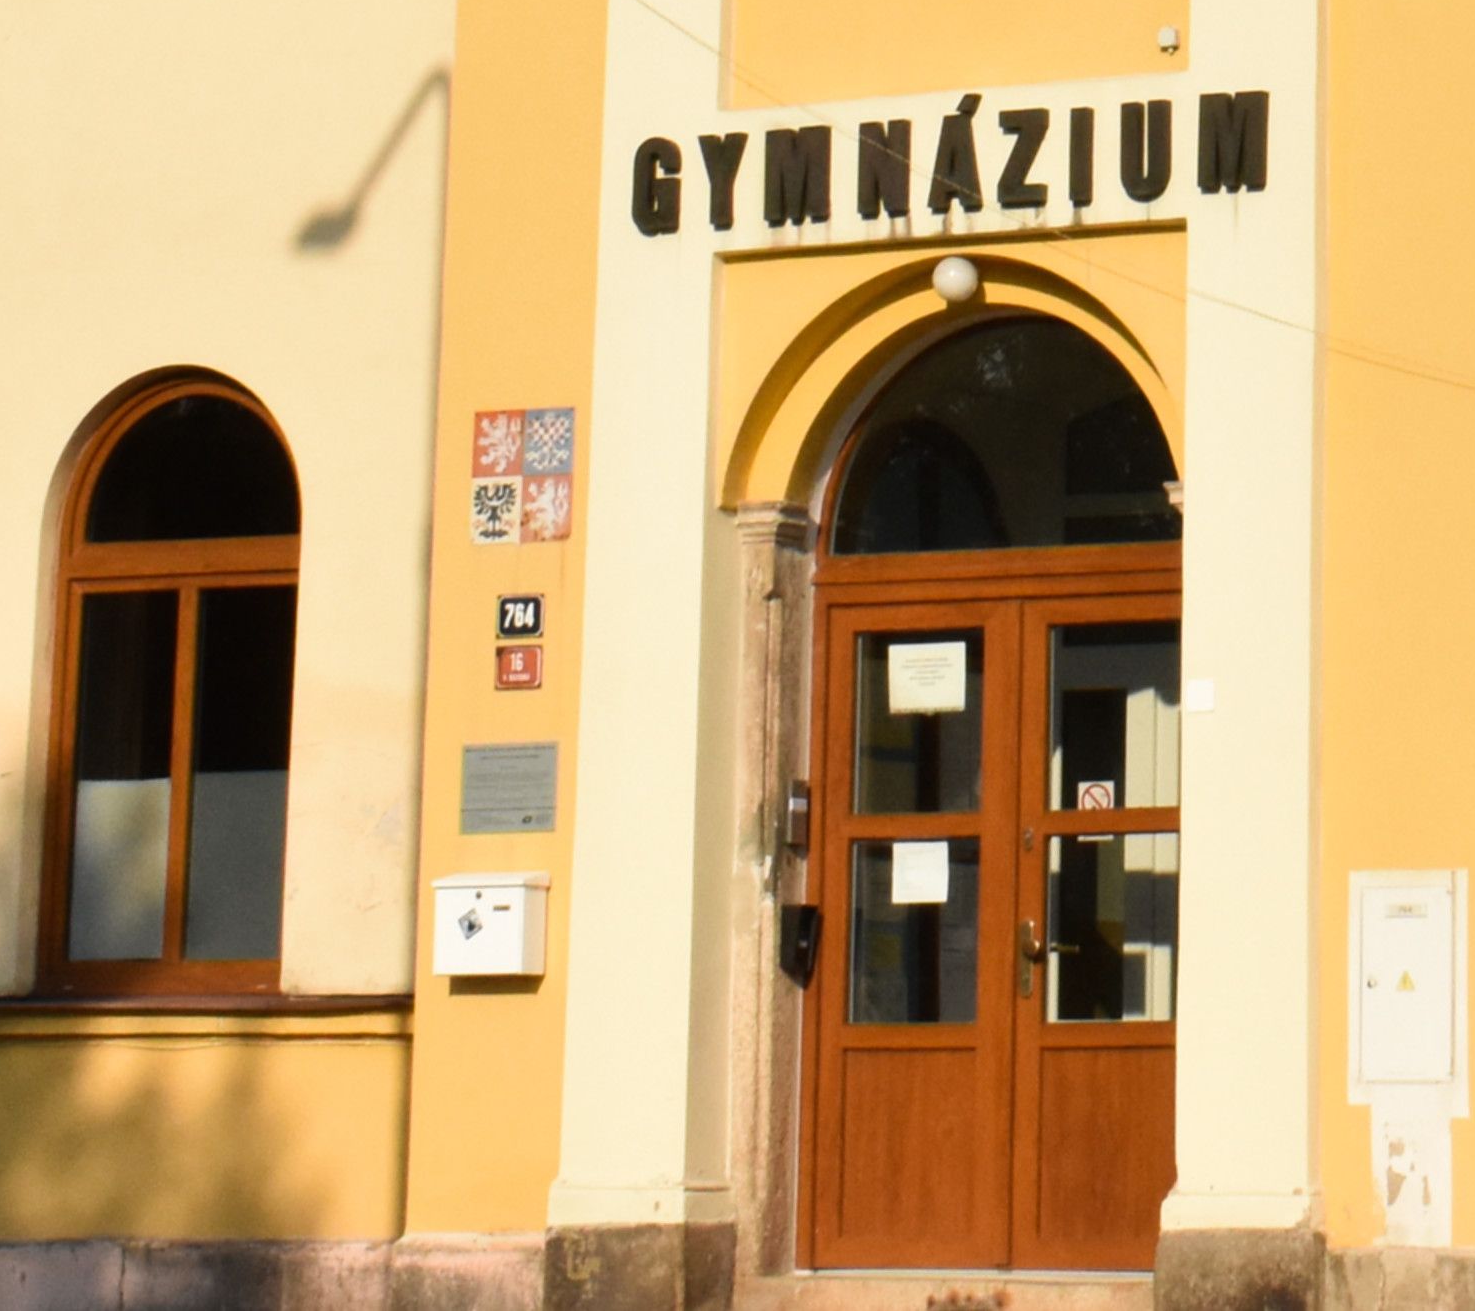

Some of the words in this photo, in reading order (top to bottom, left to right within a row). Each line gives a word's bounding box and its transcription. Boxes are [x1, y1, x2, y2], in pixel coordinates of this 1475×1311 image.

[631, 90, 1269, 237] GYMNÁZIUM
[504, 602, 535, 629] 764
[509, 652, 524, 672] 16
